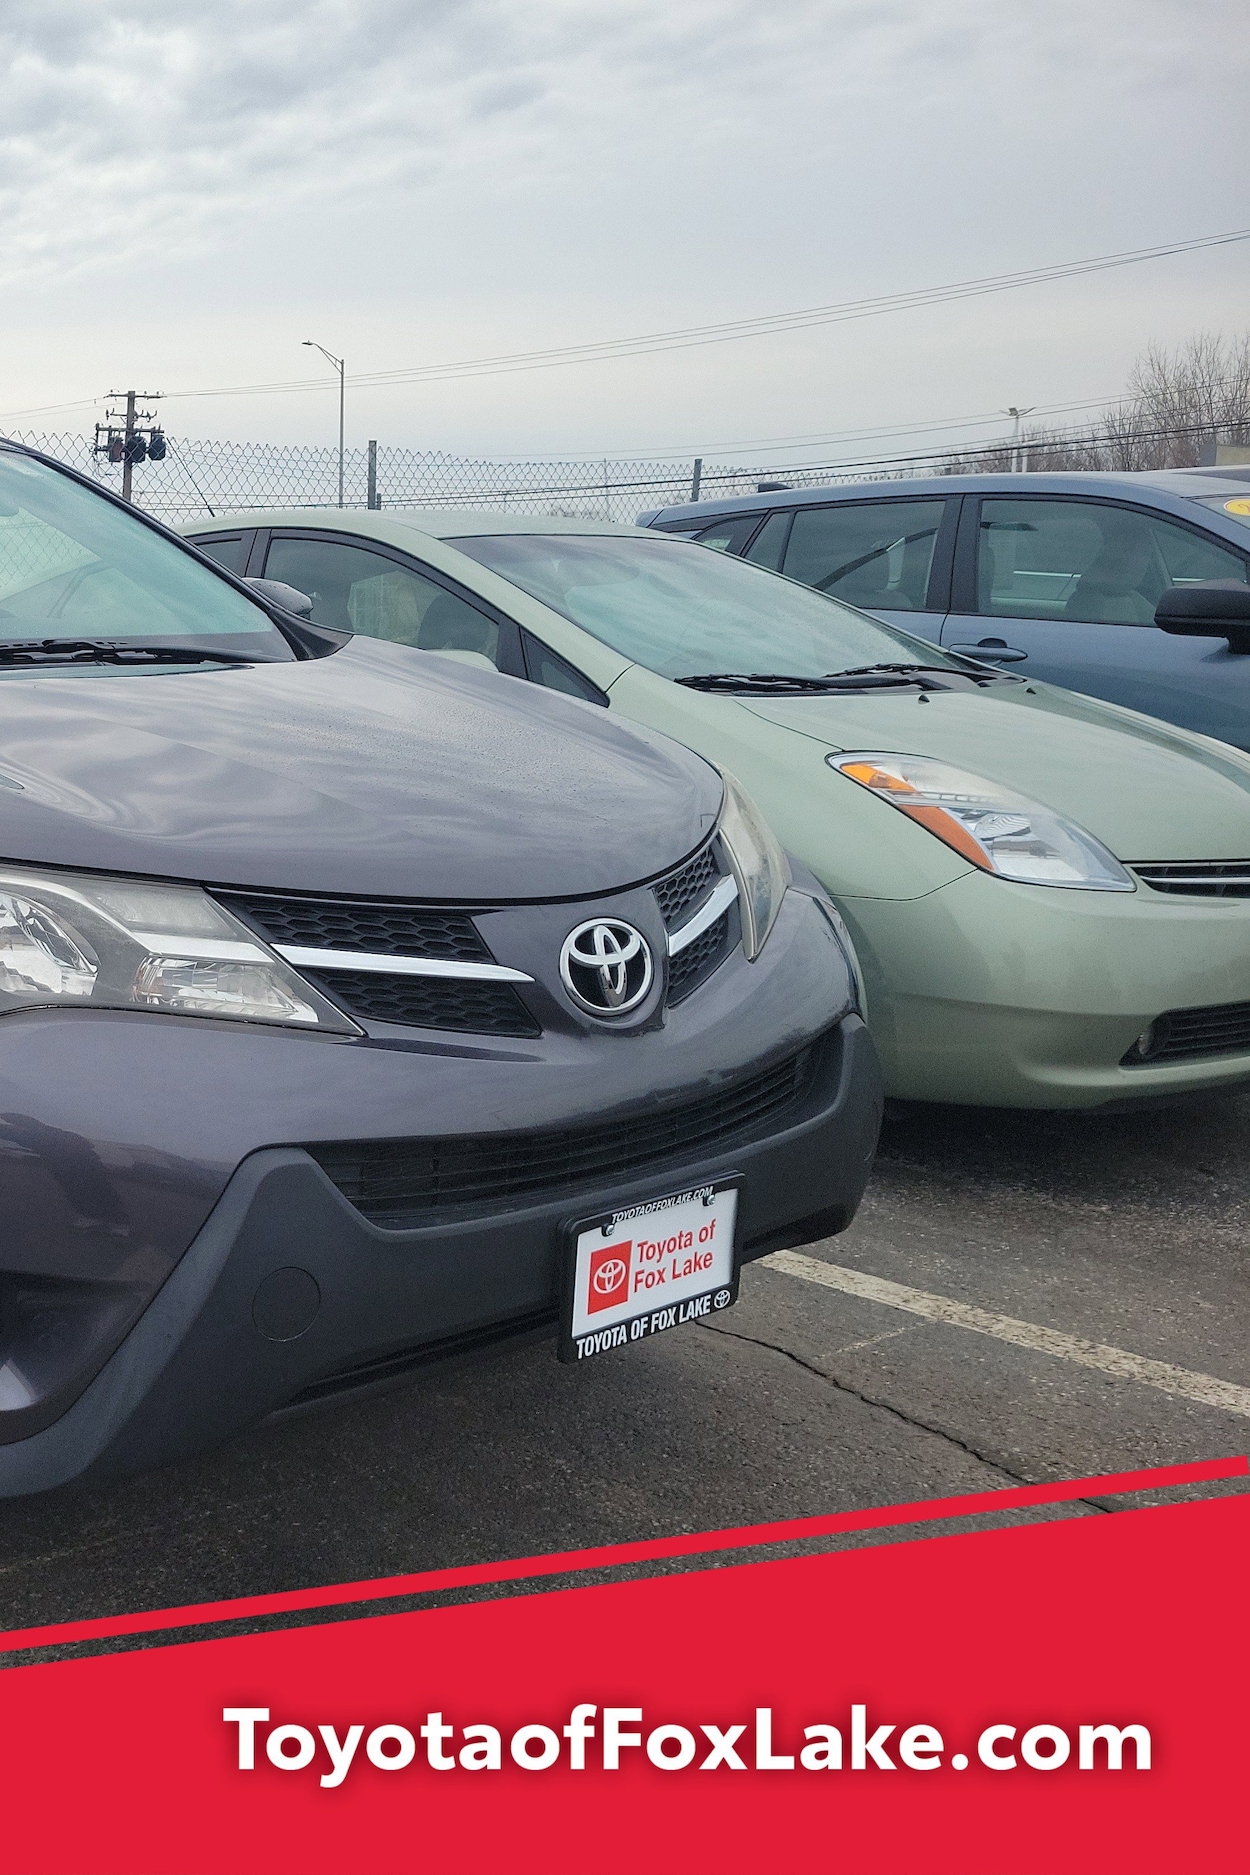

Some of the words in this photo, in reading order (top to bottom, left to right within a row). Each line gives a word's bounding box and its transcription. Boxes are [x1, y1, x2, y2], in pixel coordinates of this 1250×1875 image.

[611, 1186, 714, 1224] TOYOTAOFFOXLAKE.COM
[637, 1230, 694, 1265] Toyota
[698, 1219, 716, 1243] of
[633, 1268, 666, 1293] Fox
[671, 1251, 714, 1281] Lake
[576, 1324, 628, 1360] TOYOTA
[630, 1316, 649, 1340] OF
[650, 1306, 677, 1334] FOX
[678, 1294, 712, 1323] LAKE
